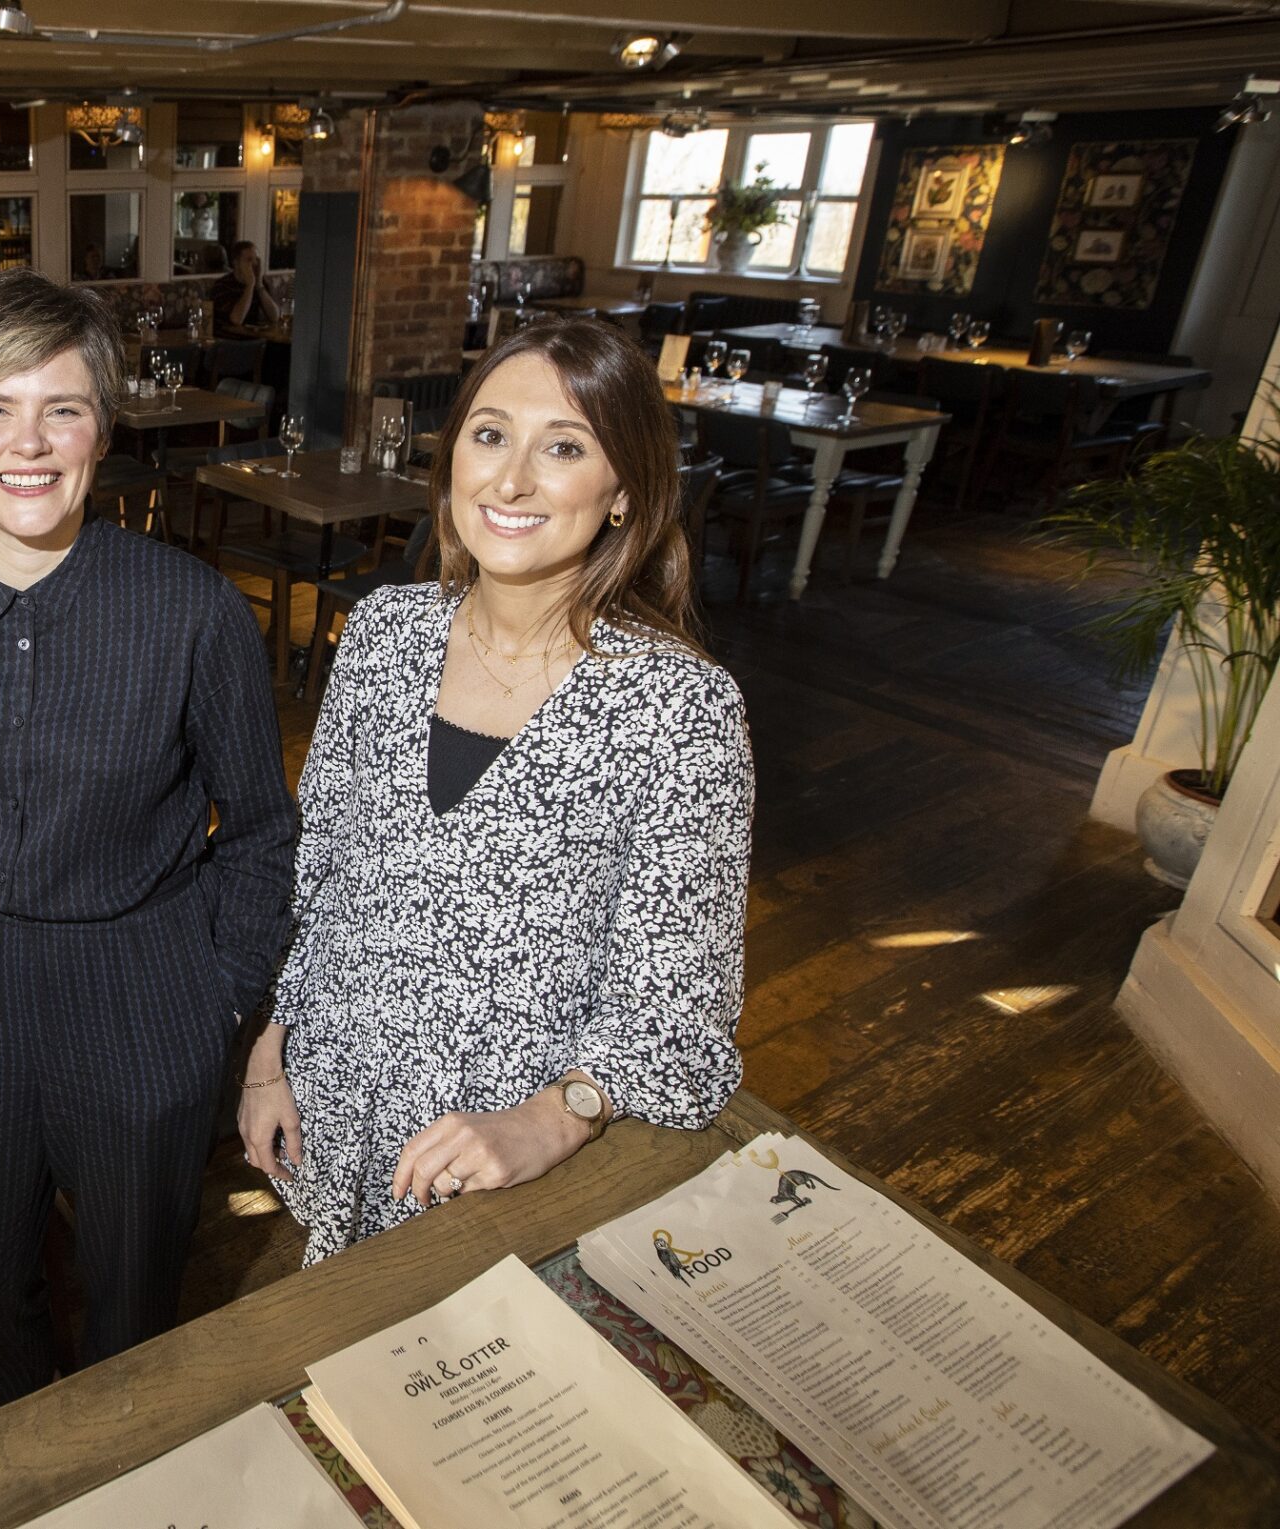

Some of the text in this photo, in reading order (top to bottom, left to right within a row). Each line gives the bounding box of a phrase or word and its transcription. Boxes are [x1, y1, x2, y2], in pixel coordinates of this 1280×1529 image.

[787, 1231, 813, 1250] Mains
[683, 1247, 732, 1279] FOOD
[694, 1281, 728, 1302] Starters
[391, 1346, 406, 1357] THE
[404, 1337, 511, 1397] OWL & OTTER
[408, 1370, 424, 1381] THE
[439, 1365, 498, 1399] FIXED PRICE MENU
[437, 1409, 465, 1427] COURSES
[489, 1381, 517, 1400] COURSES
[515, 1369, 536, 1385] £13.95
[449, 1394, 469, 1406] Monday
[470, 1384, 486, 1395] Friday
[483, 1405, 513, 1425] STARTERS
[559, 1489, 582, 1505] MAINS
